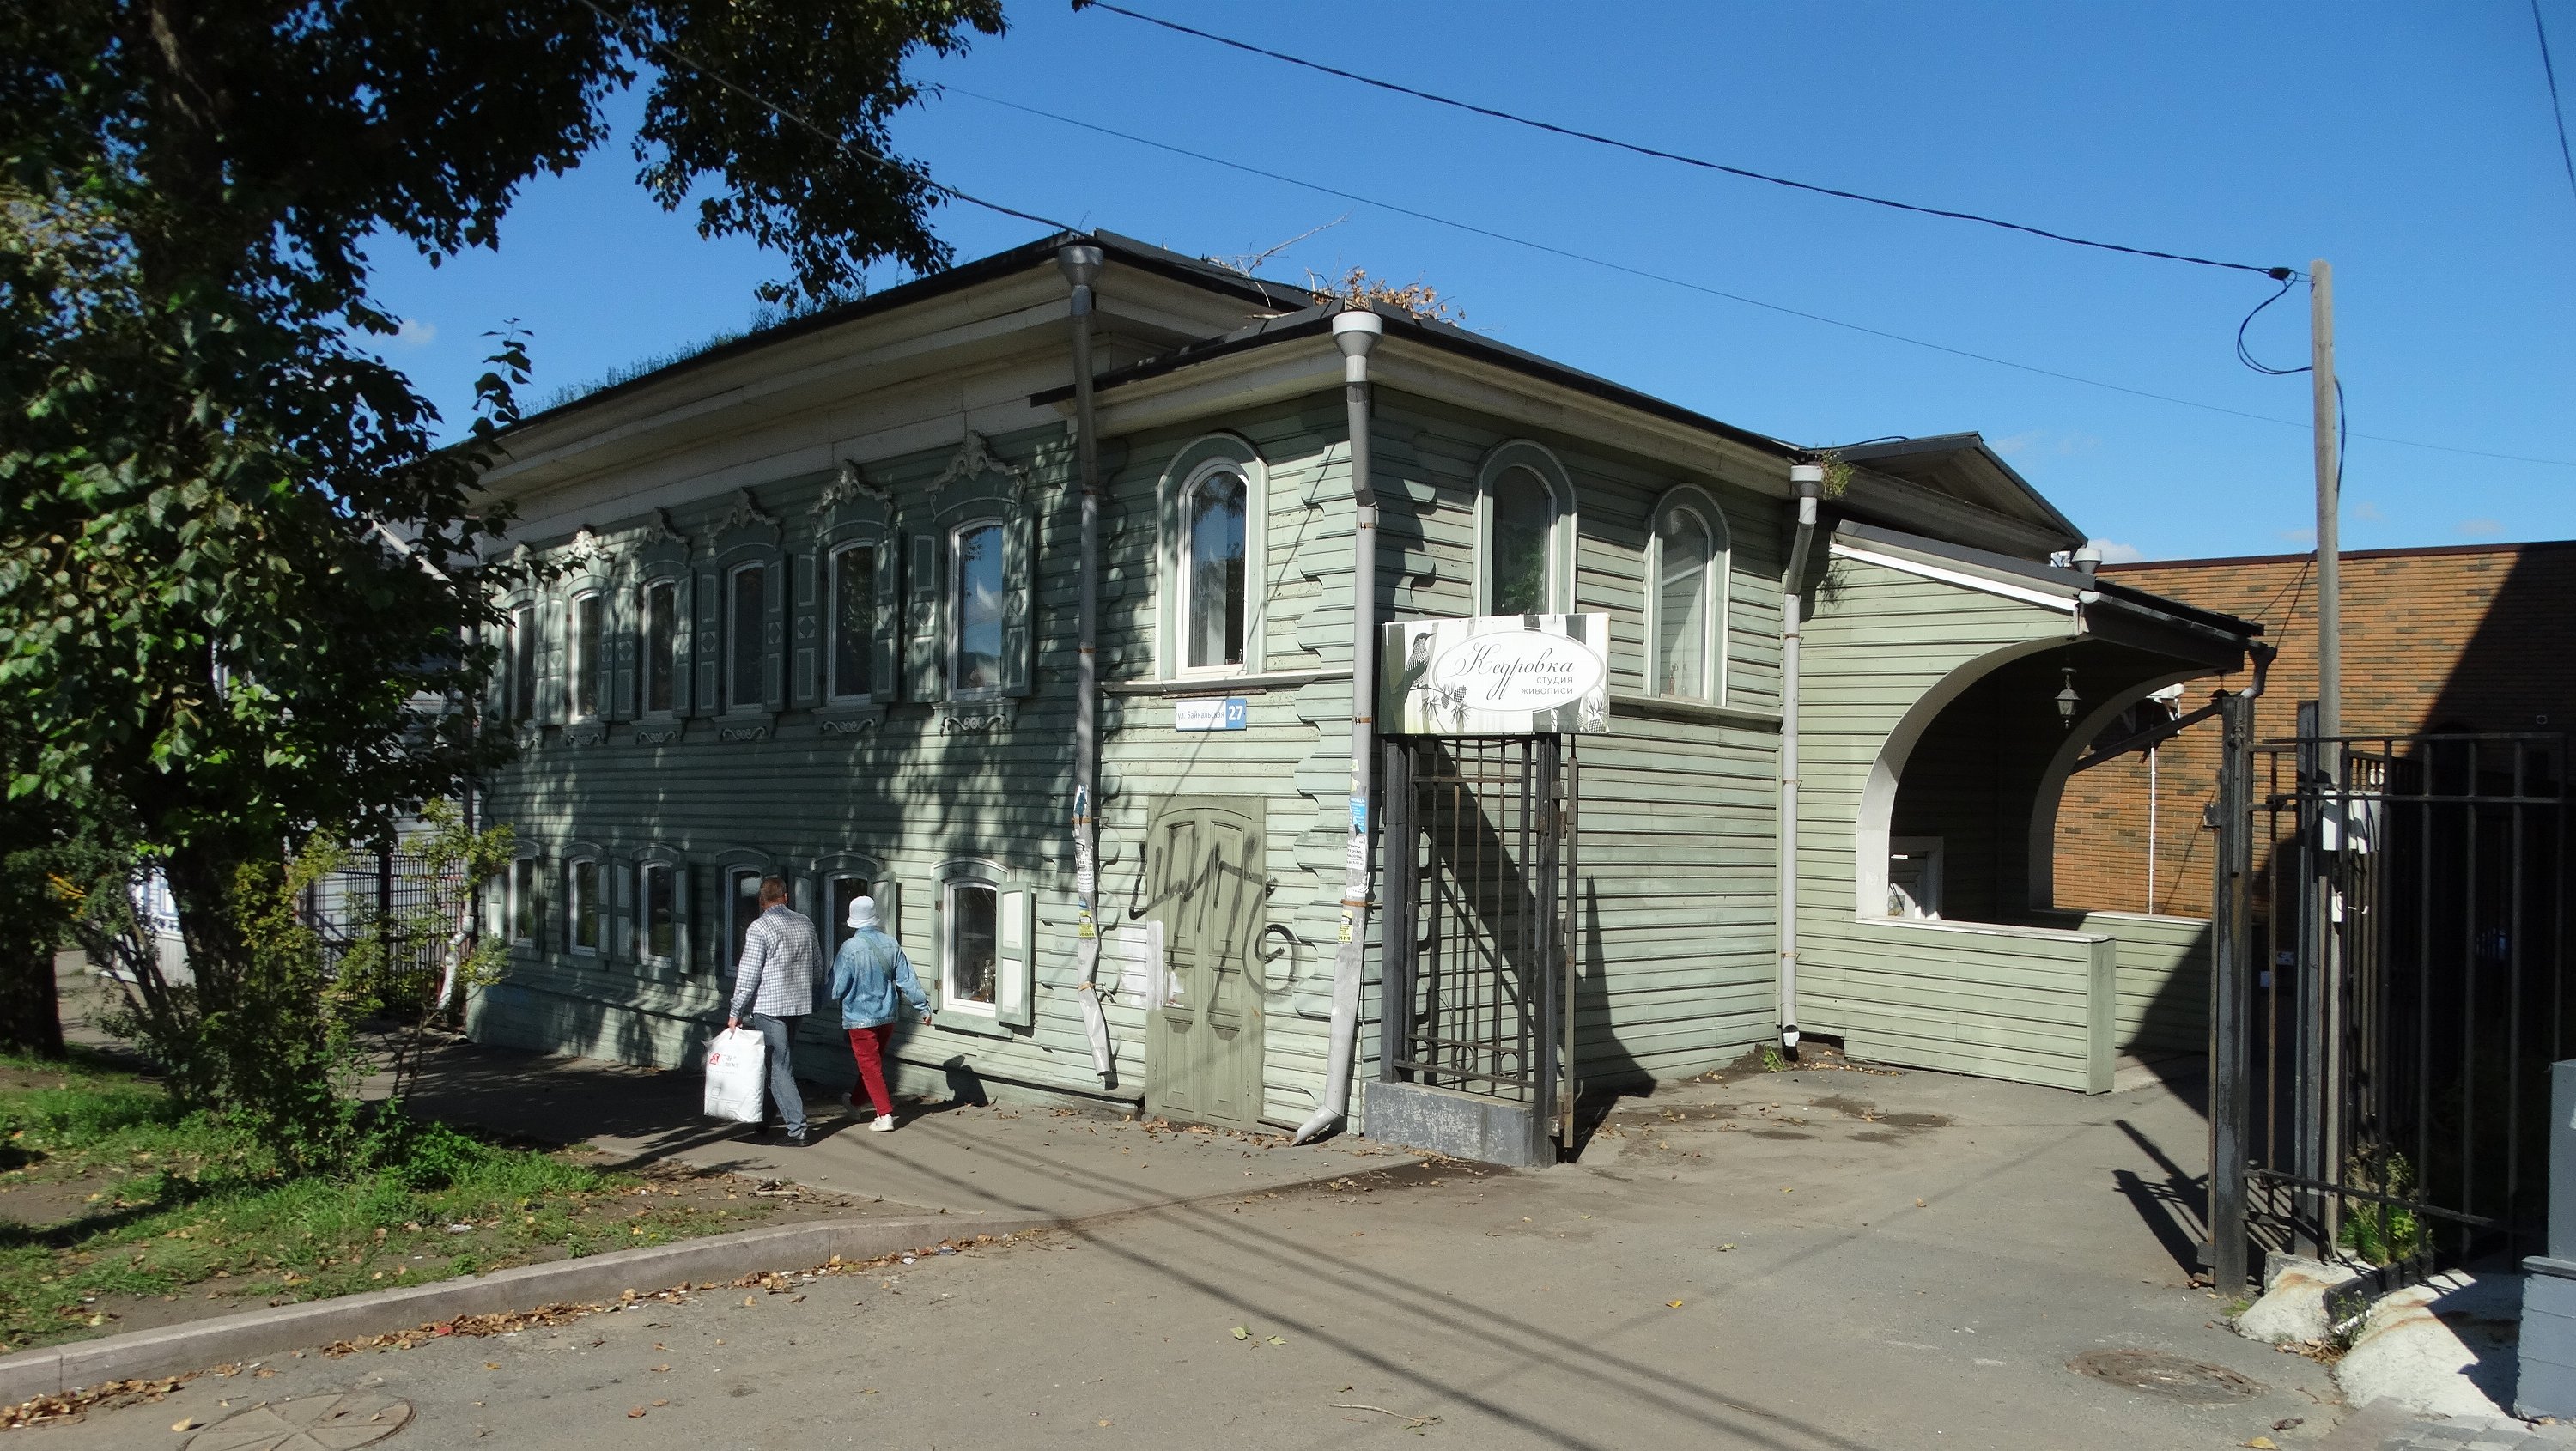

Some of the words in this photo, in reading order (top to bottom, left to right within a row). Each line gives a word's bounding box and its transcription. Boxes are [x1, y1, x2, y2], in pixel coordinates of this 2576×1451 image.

[1443, 642, 1574, 700] Кедровка
[1187, 710, 1224, 719] Байкальская
[1228, 705, 1243, 721] 27
